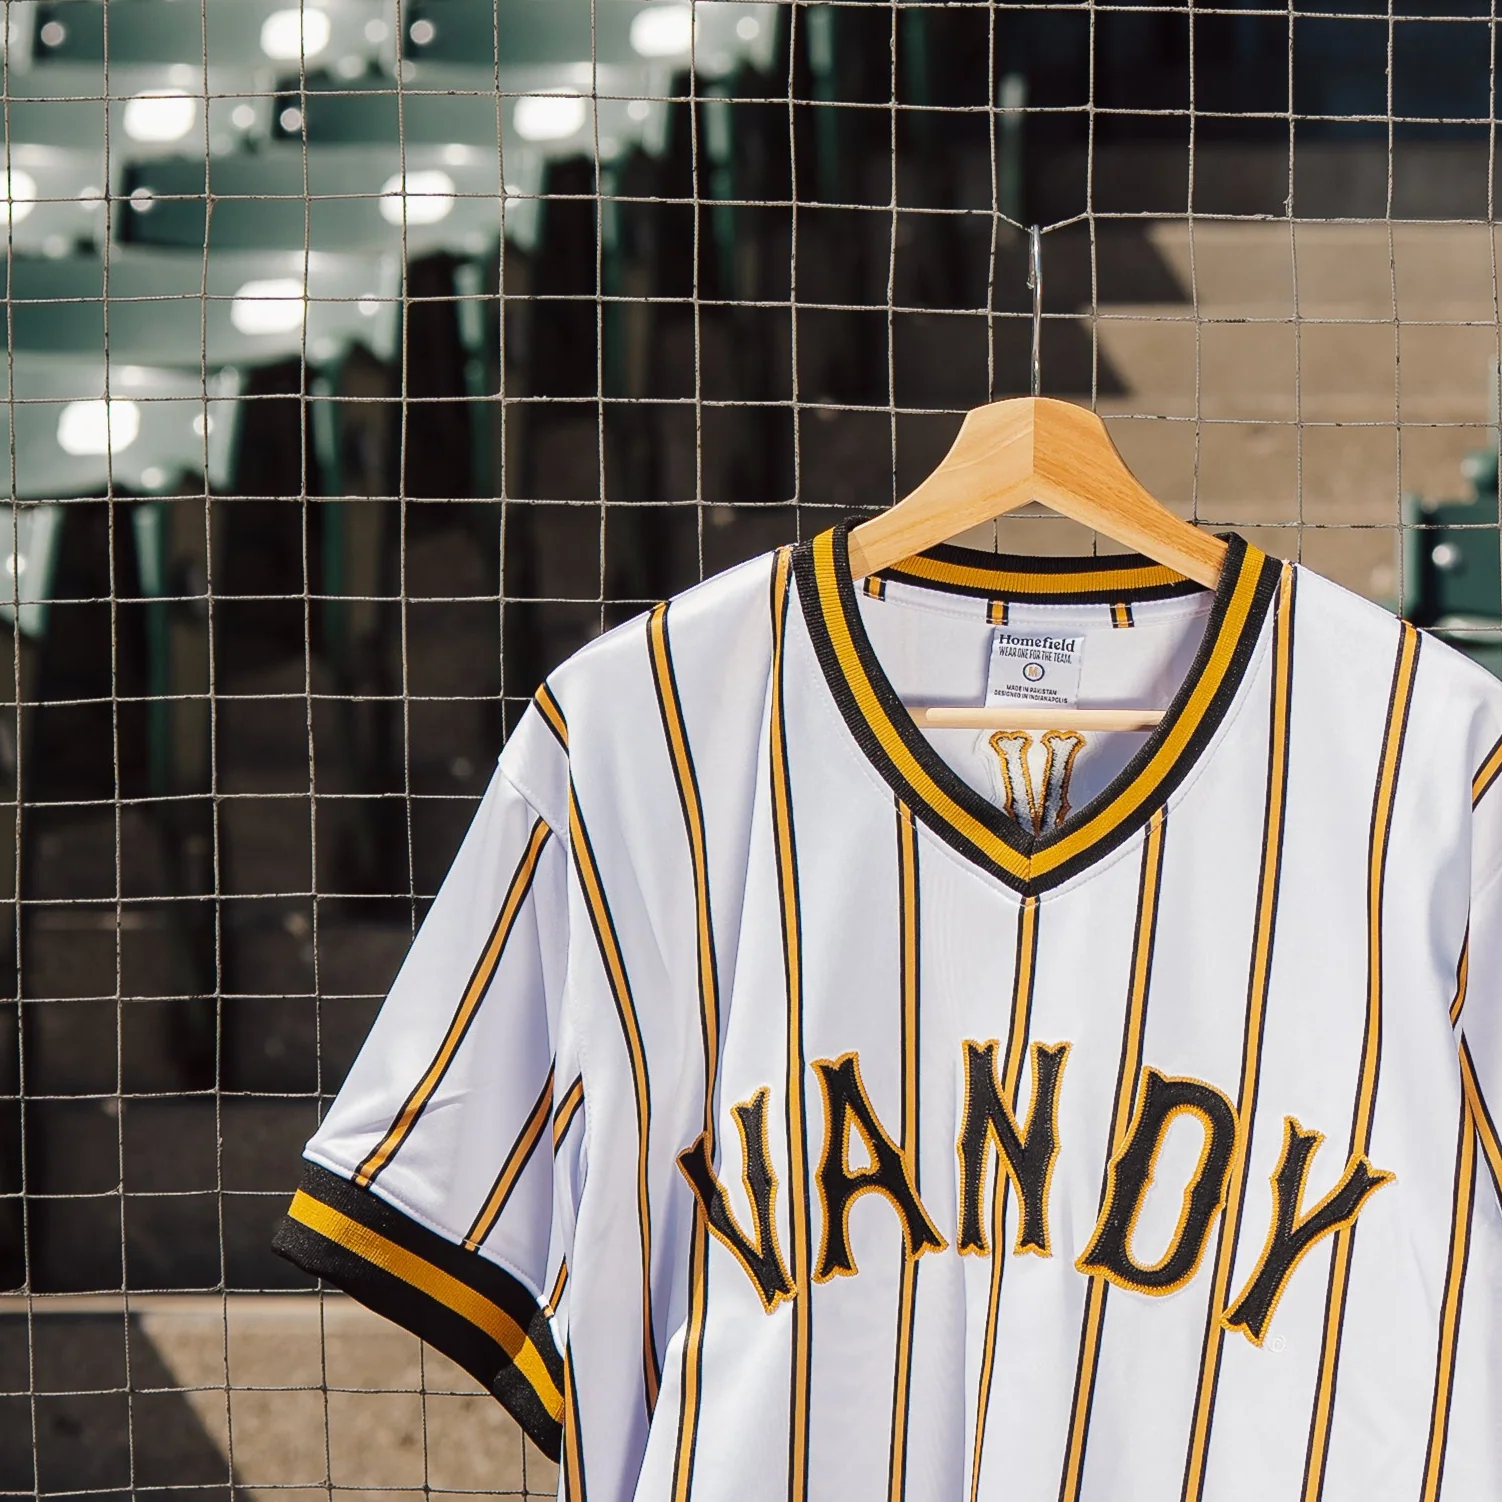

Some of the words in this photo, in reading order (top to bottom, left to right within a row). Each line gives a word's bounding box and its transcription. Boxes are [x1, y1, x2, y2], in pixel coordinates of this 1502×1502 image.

[998, 634, 1076, 652] Homefield
[998, 646, 1017, 658] WEAR
[1017, 648, 1029, 659] ONE
[1029, 649, 1041, 660] FOR
[1041, 650, 1053, 662] THE
[1053, 652, 1072, 664] TEAM.
[1028, 666, 1039, 677] M
[994, 689, 1021, 698] DESIGNED
[1028, 693, 1068, 704] INDIANAPOLIS
[1006, 684, 1022, 692] MADE
[1030, 687, 1058, 695] PAKISTAN
[676, 1039, 1398, 1348] VANDY
